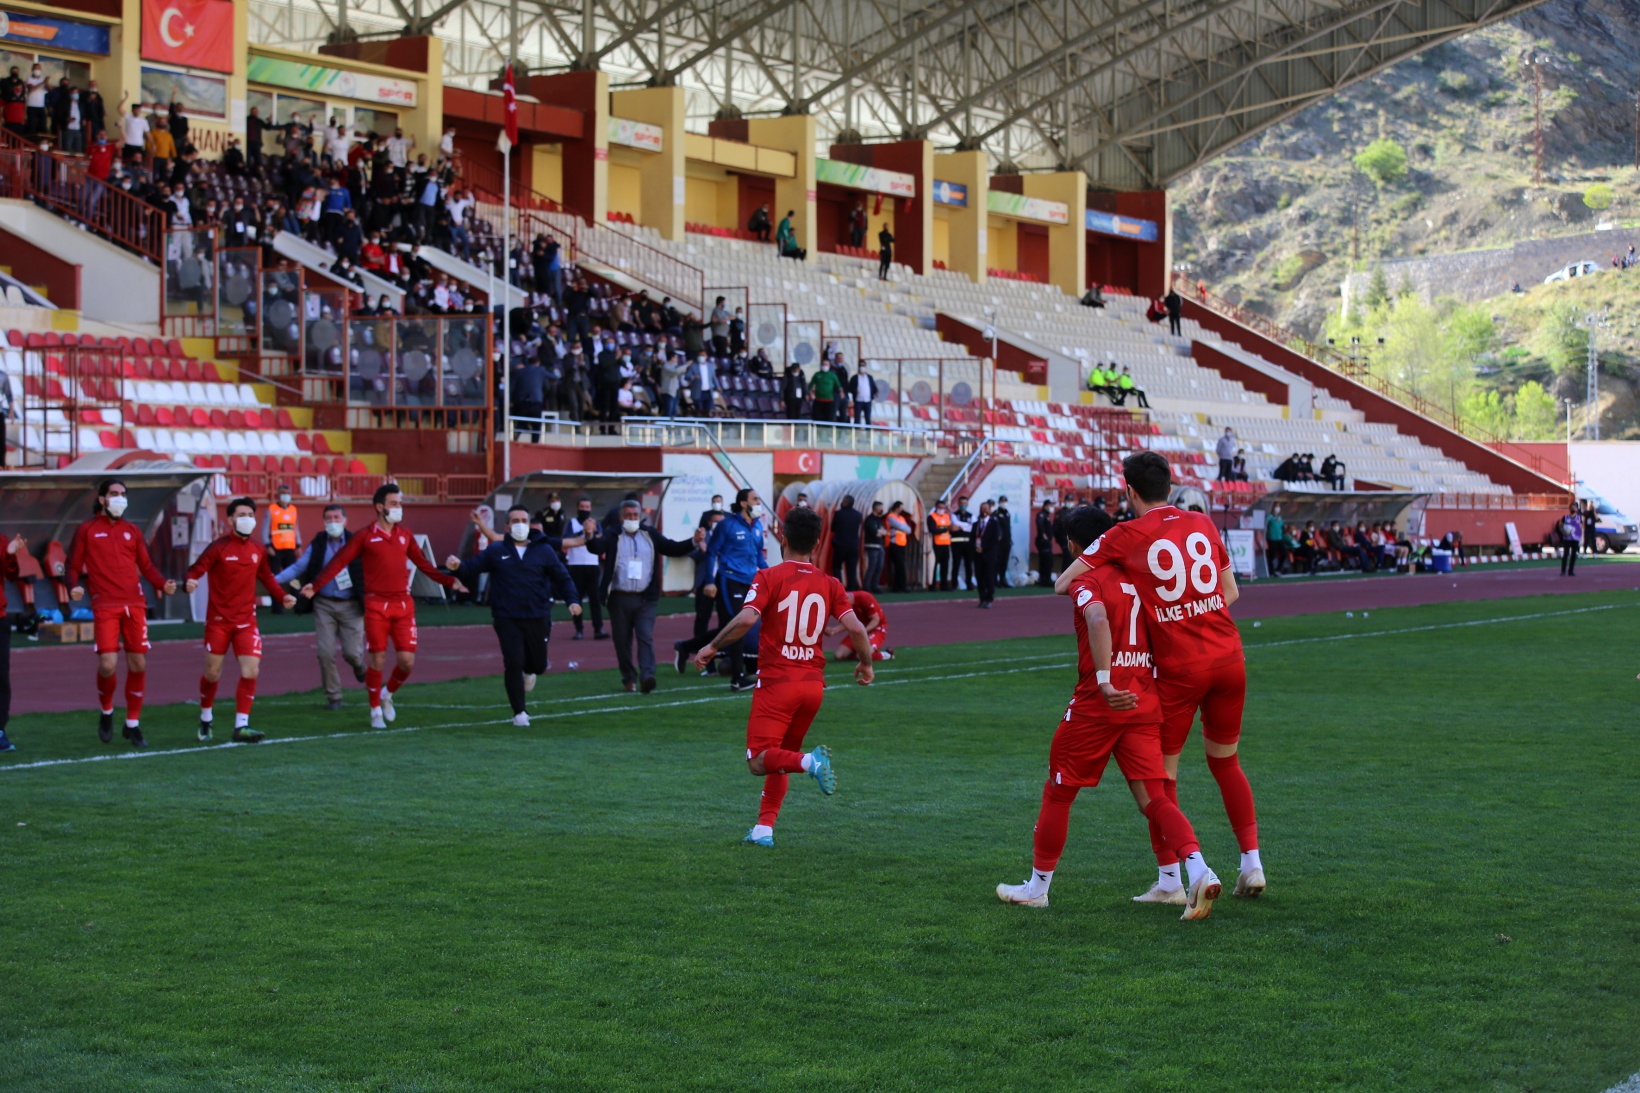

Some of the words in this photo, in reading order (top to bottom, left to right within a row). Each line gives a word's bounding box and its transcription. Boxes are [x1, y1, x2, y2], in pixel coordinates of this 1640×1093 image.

[1147, 532, 1218, 602] 98
[777, 590, 826, 646] 10
[1120, 582, 1141, 646] 7
[1155, 605, 1184, 623] İLKE
[781, 644, 815, 661] ADAR
